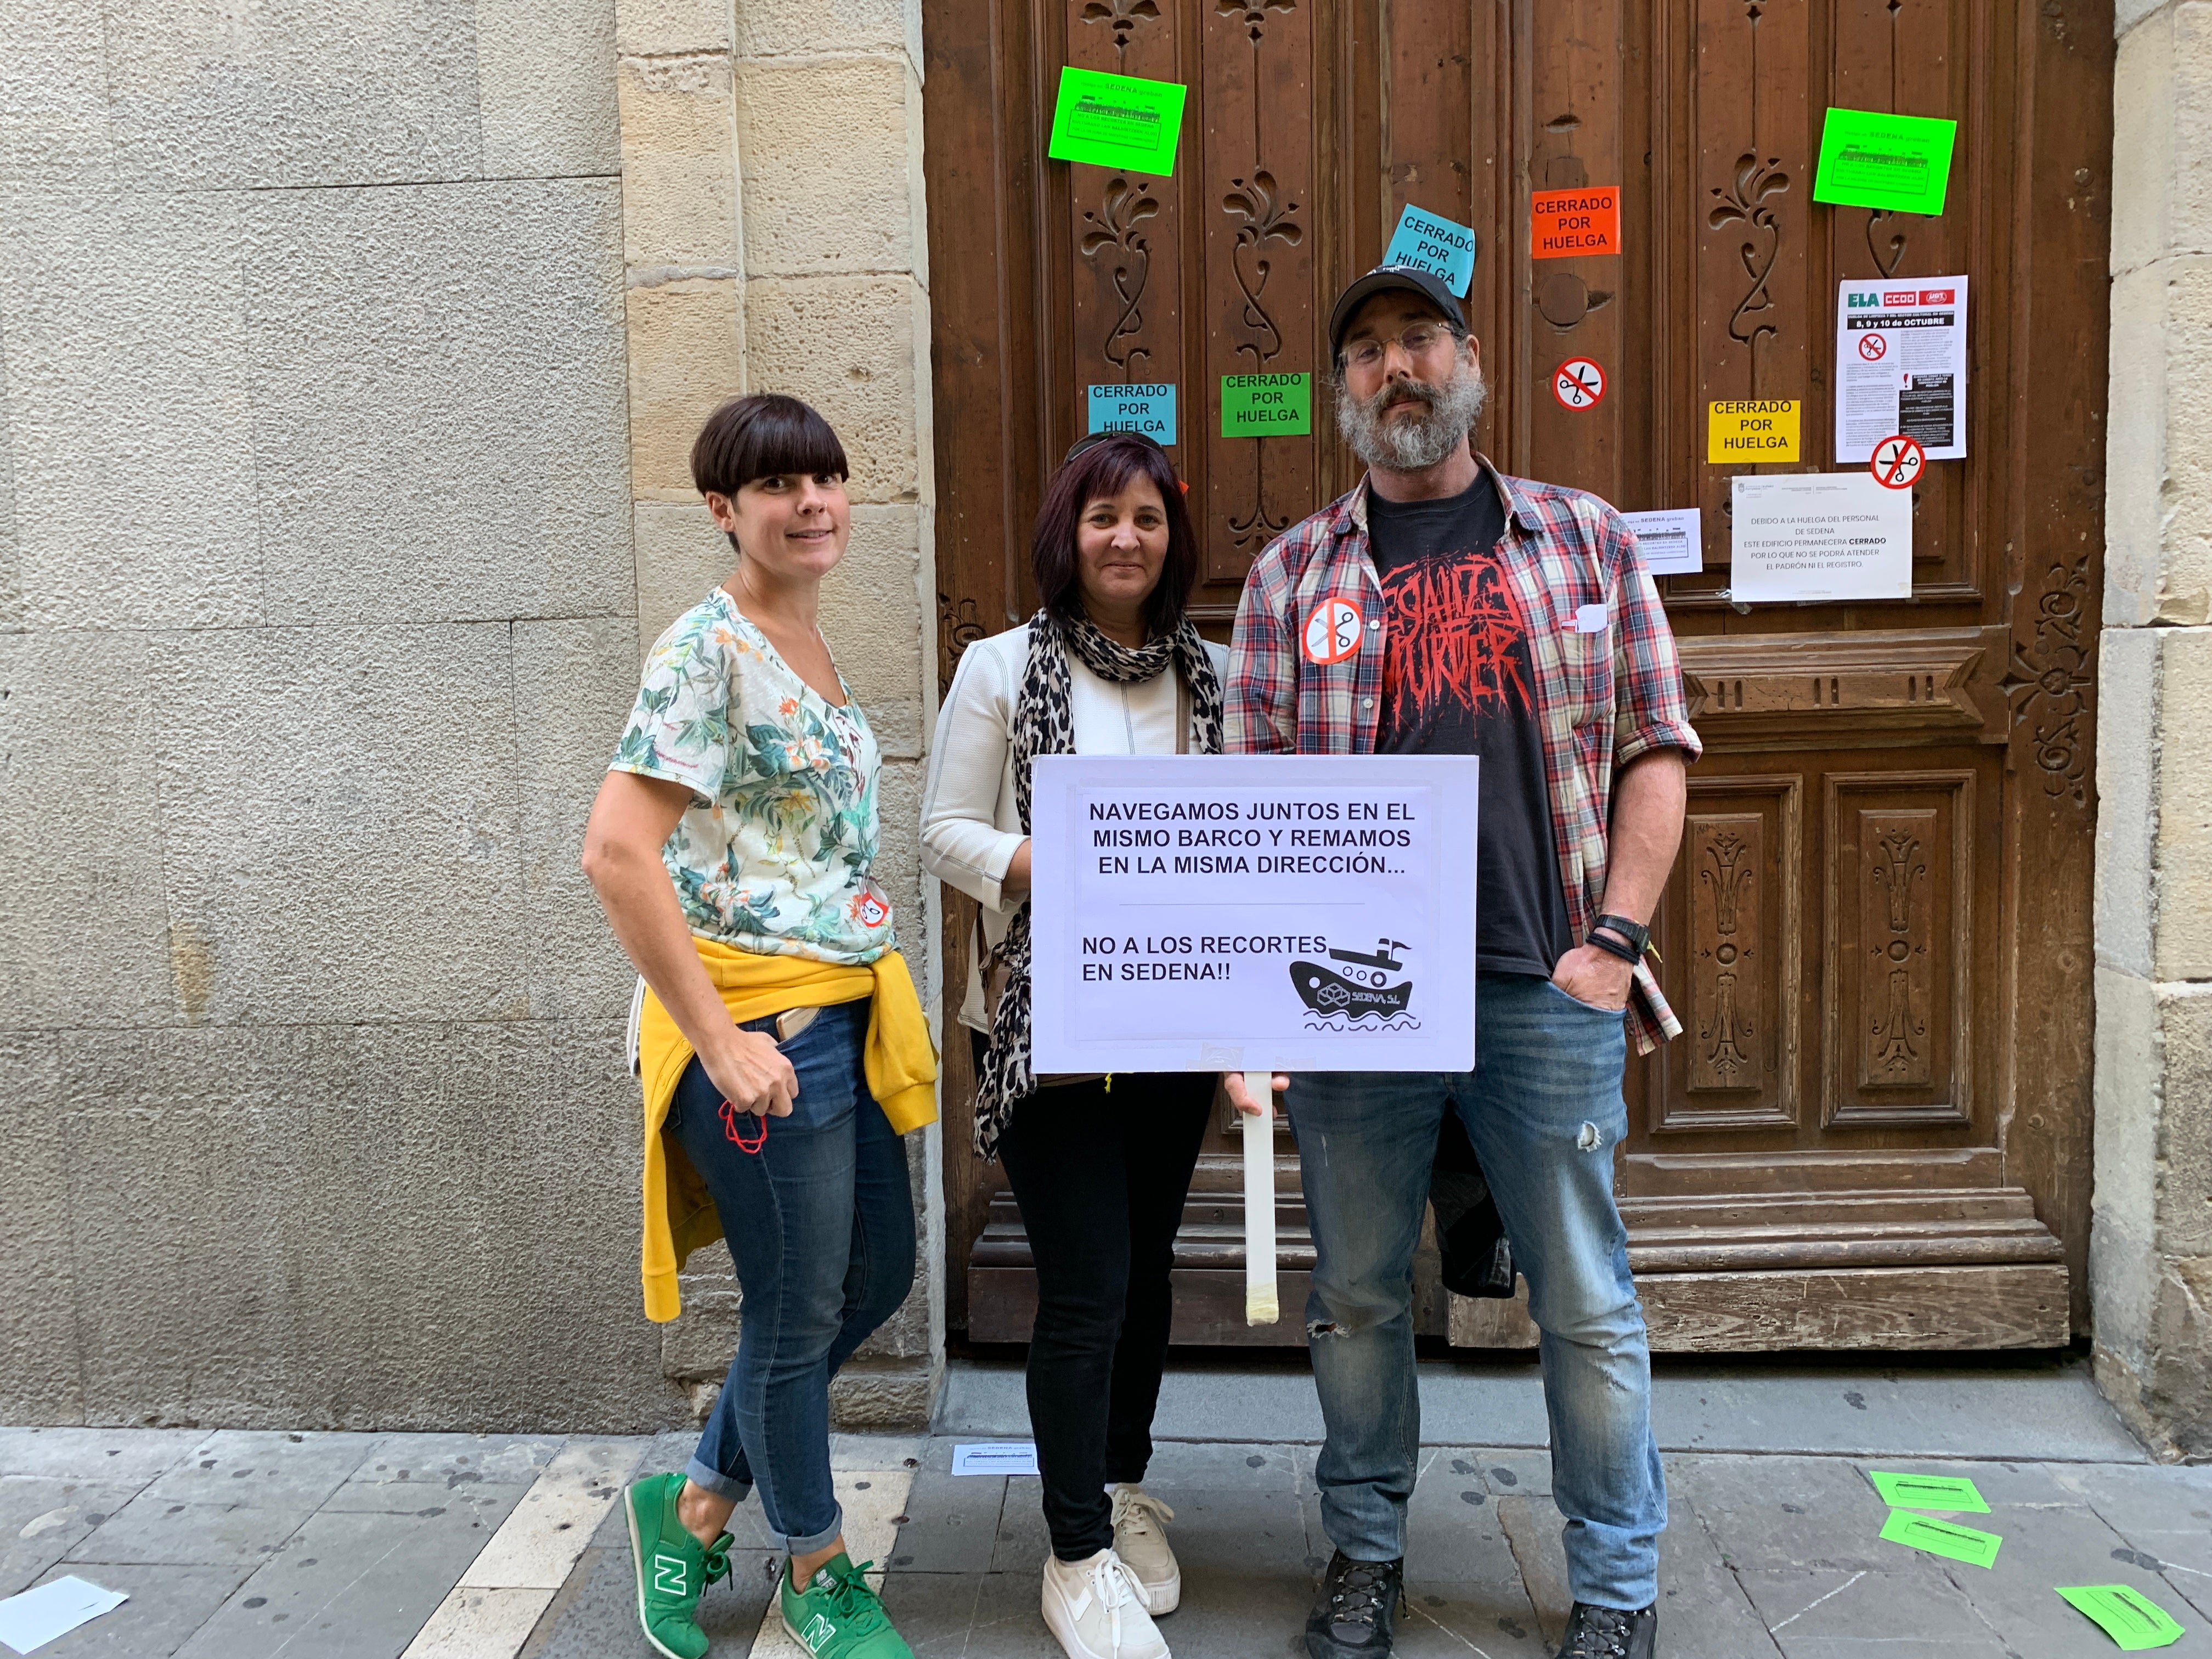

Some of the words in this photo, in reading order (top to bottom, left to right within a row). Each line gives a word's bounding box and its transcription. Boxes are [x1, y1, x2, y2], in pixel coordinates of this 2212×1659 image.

[1105, 83, 1137, 93] SEDENA
[1870, 132, 1903, 140] SEDENA
[1536, 197, 1612, 214] CERRADO
[1559, 217, 1590, 230] POR
[1404, 216, 1473, 252] CERRADO
[1543, 234, 1607, 250] HUELGA
[1417, 240, 1449, 262] POR
[1848, 293, 1880, 307] ELA
[1885, 294, 1915, 304] CCOO
[1857, 320, 1864, 329] 8,
[1904, 317, 1945, 326] OCTUBRE
[1226, 374, 1301, 388] CERRADO
[1093, 385, 1167, 398] CERRADO
[1252, 392, 1283, 404] POR
[1119, 403, 1149, 415] POR
[1715, 401, 1791, 414] CERRADO
[1237, 410, 1299, 422] HUELGA
[1104, 421, 1165, 433] HUELGA
[1741, 419, 1772, 431] POR
[1725, 437, 1788, 449] HUELGA
[1819, 549, 1844, 557] PODRÁ
[1091, 803, 1238, 820] NAVEGAMOS
[1246, 803, 1339, 820] JUNTOS
[1348, 803, 1377, 820] EN
[1387, 803, 1415, 820] EL
[1094, 830, 1170, 847] MISMO
[1179, 830, 1260, 847] BARCO
[1268, 830, 1283, 846] Y
[1291, 830, 1410, 847] REMAMOS
[1099, 857, 1128, 873] EN
[1138, 857, 1166, 873] LA
[1175, 856, 1249, 873] MISMA
[1258, 851, 1404, 873] DIRECCIÓN...
[1084, 937, 1115, 954] NO
[1123, 938, 1139, 953] A
[1148, 937, 1192, 953] LOS
[1201, 936, 1326, 953] RECORTES
[1084, 964, 1112, 981] EN
[1121, 963, 1229, 980] SEDENA!!
[654, 1554, 686, 1596] N
[801, 1613, 836, 1654] N
